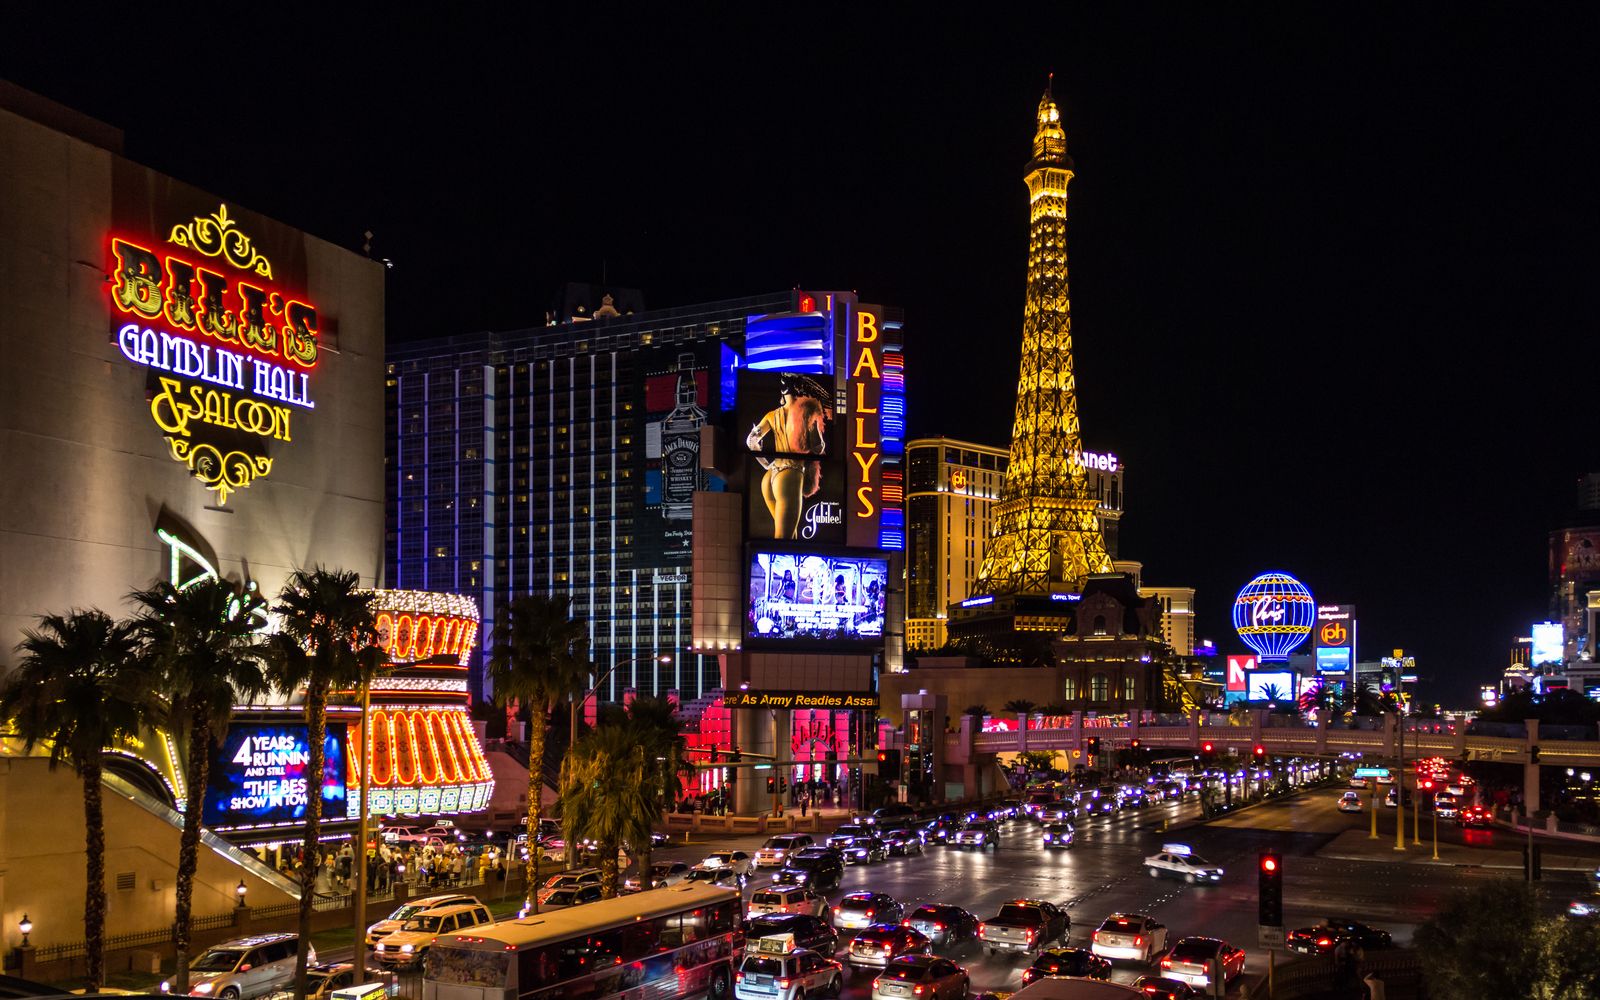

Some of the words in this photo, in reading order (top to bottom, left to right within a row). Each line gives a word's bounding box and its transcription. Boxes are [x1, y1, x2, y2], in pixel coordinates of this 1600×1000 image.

[111, 237, 318, 367] BILL'S
[118, 324, 253, 389] GAMBLIN'
[254, 358, 315, 409] HALL
[188, 386, 292, 442] SALOON
[801, 502, 842, 539] Jubilee!
[660, 574, 686, 582] VECTOR
[1322, 622, 1347, 643] ph
[741, 694, 757, 705] As
[760, 694, 792, 708] Army
[795, 695, 842, 706] Readies
[232, 736, 252, 766] 4
[252, 736, 295, 751] YEARS
[253, 751, 310, 766] RUNNIN
[244, 768, 265, 777] AND
[266, 767, 286, 776] STILL
[280, 778, 308, 795] BES
[230, 796, 268, 810] SHOW
[269, 794, 284, 807] IN
[284, 793, 309, 806] TOW
